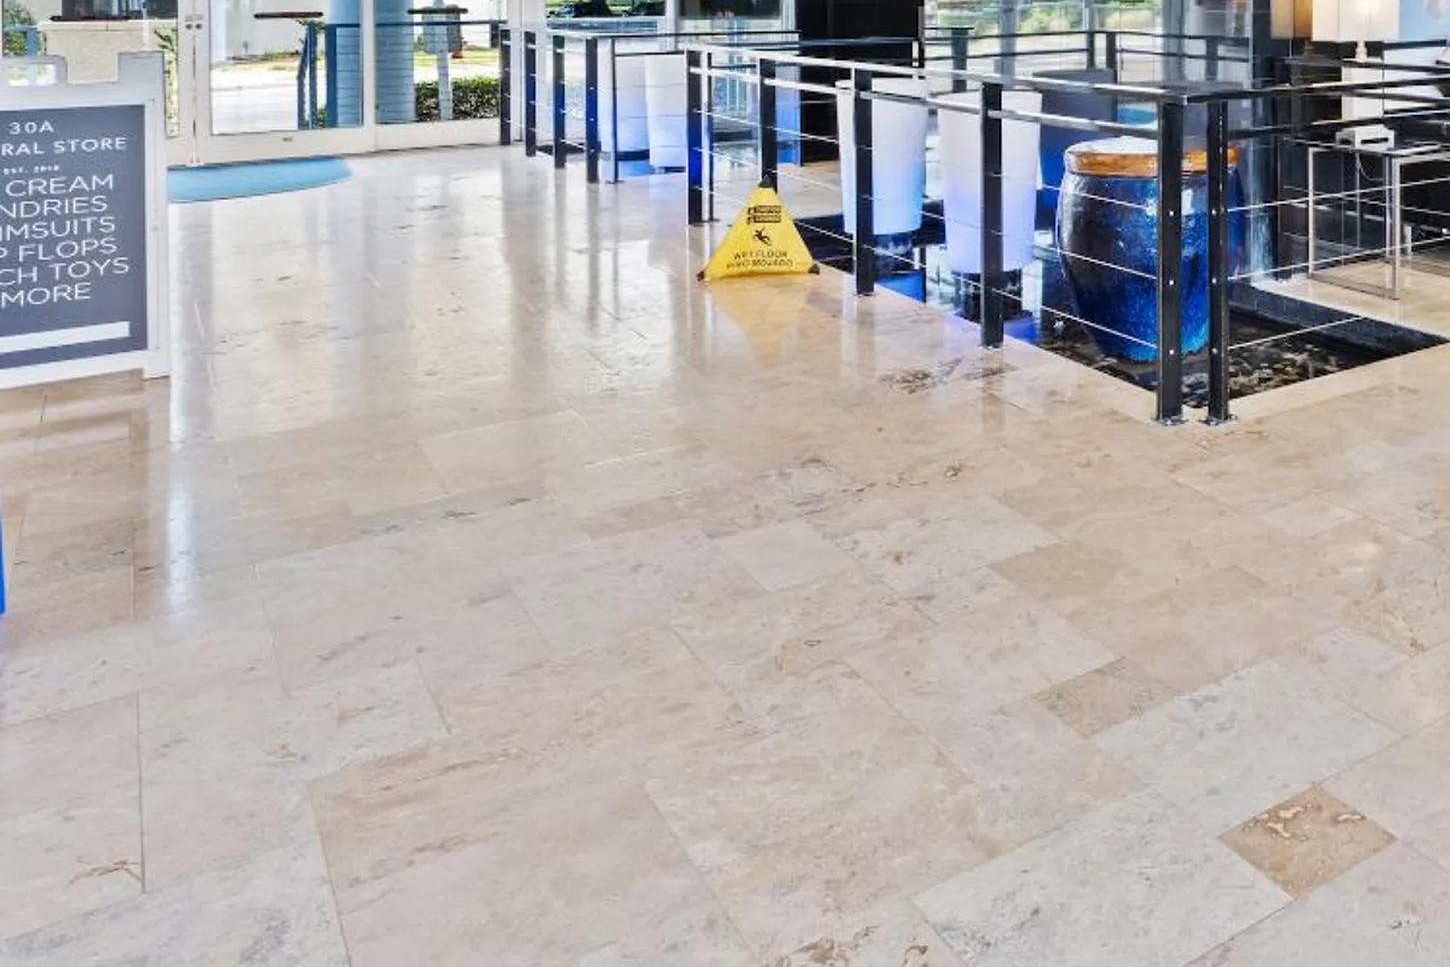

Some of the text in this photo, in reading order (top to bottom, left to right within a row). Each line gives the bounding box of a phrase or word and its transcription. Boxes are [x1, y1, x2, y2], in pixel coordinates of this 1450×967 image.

[9, 120, 54, 135] 30A
[53, 137, 127, 154] STORE
[5, 174, 114, 197] CREAM
[19, 237, 117, 262] FLOPS
[49, 257, 129, 280] TOYS
[1, 282, 91, 308] MORE
